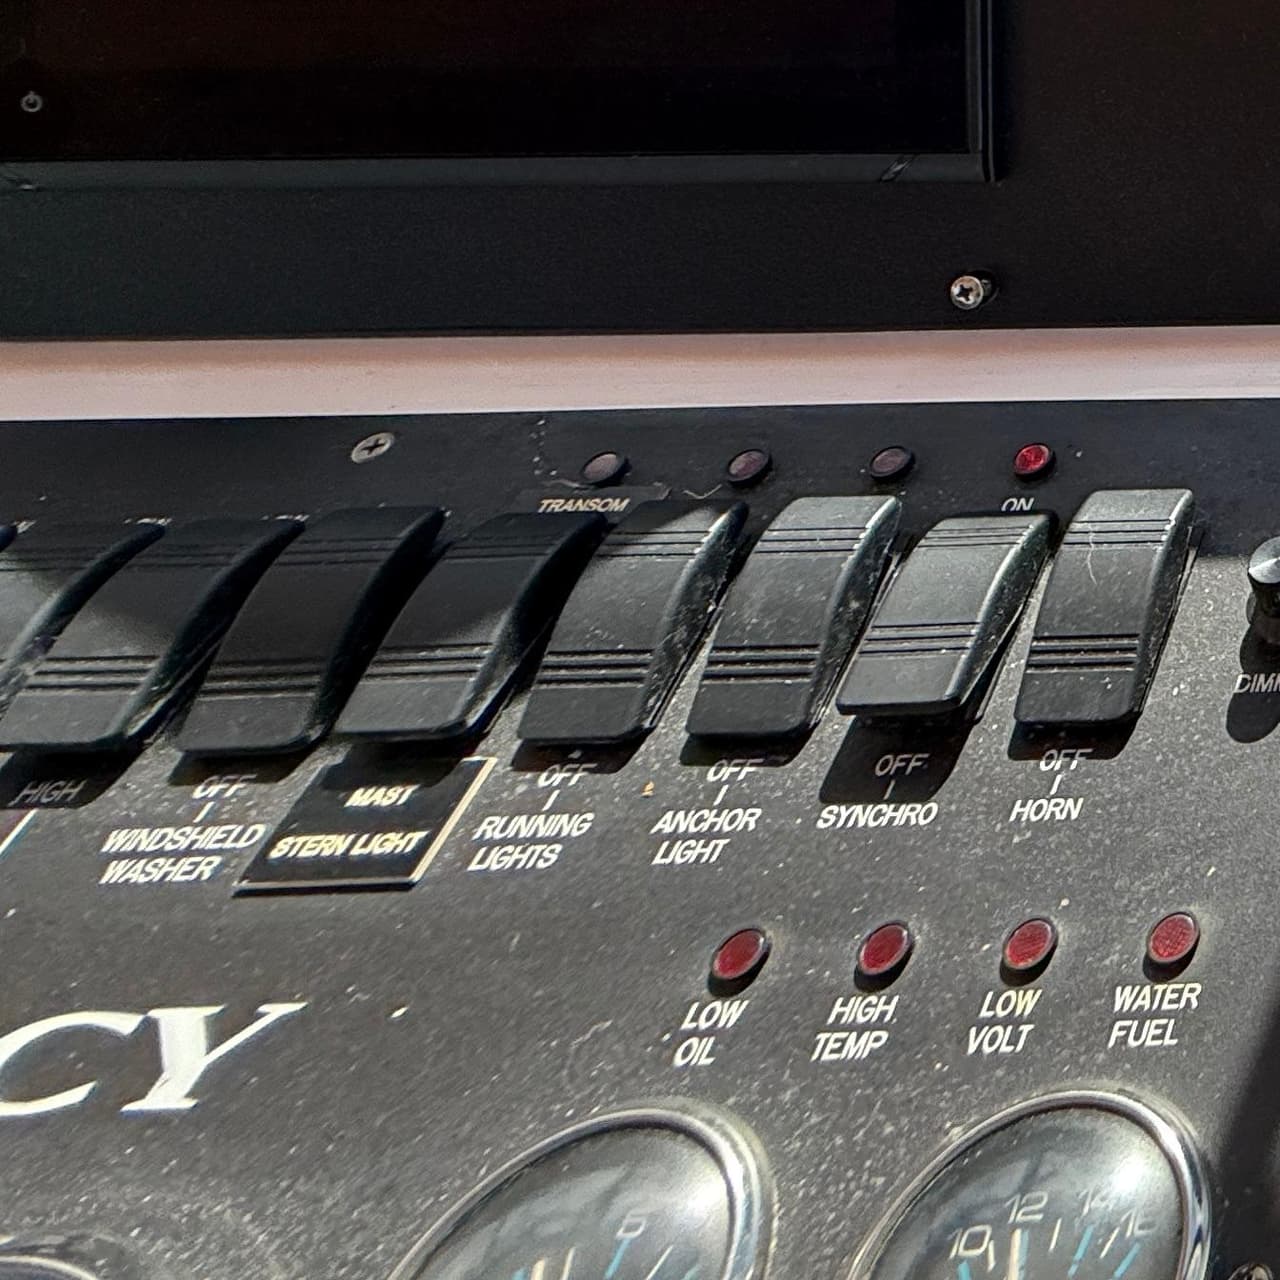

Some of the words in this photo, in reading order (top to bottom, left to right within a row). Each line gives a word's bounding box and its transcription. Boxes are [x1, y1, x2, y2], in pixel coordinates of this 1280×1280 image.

[538, 498, 630, 513] TRANSOM
[1001, 497, 1035, 512] ON
[706, 757, 766, 782] OFF
[873, 752, 931, 777] OFF
[1039, 748, 1094, 772] OFF
[191, 773, 258, 800] OFF
[537, 763, 598, 788] OFF
[8, 779, 89, 807] HIGH
[344, 784, 421, 808] MAST
[650, 807, 763, 834] ANCHOR
[816, 802, 939, 829] SYNCHRO
[1009, 797, 1084, 822] HORN
[101, 823, 268, 853] WINDSHIELD
[471, 812, 595, 841] RUNNING
[267, 832, 354, 860] STERN
[351, 829, 430, 855] LIGHT
[467, 843, 563, 872] LIGHTS
[651, 838, 730, 866] LIGHT
[99, 856, 223, 885] WASHER
[827, 996, 899, 1025] HIGH
[979, 989, 1044, 1019] LOW
[1113, 983, 1202, 1012] WATER
[679, 999, 750, 1031] LOW
[810, 1030, 890, 1062] TEMP
[966, 1024, 1035, 1055] VOLT
[1108, 1019, 1180, 1048] FUEL
[673, 1036, 716, 1066] OIL
[1004, 1190, 1050, 1224] 12
[949, 1223, 994, 1261] 10
